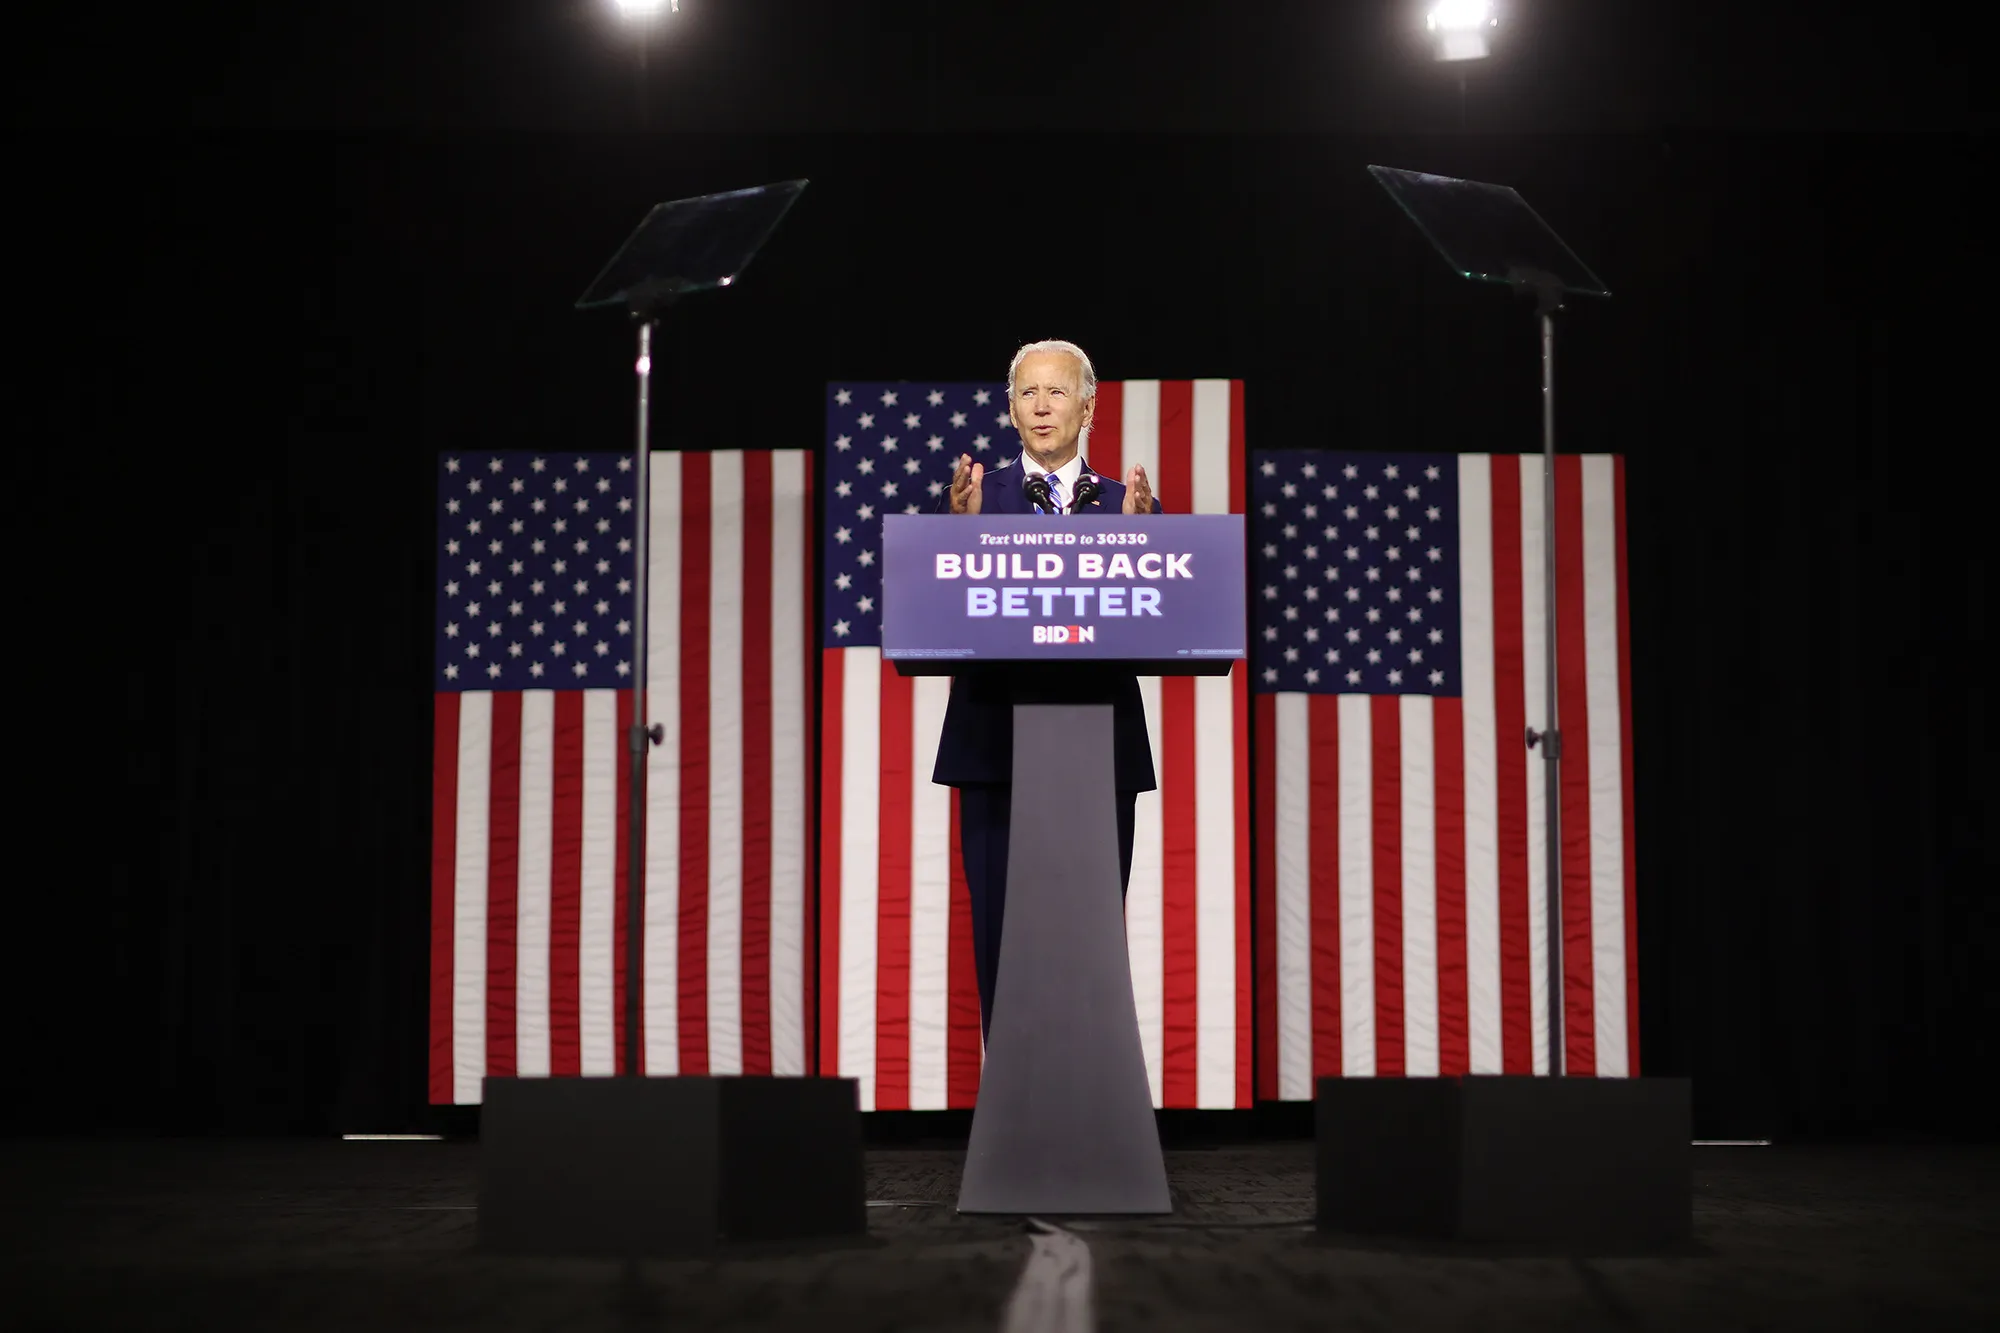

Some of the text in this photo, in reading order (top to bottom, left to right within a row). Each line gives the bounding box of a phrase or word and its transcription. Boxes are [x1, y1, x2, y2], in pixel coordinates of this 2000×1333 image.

[980, 533, 1148, 545] Text UNITED to 30330
[936, 553, 1193, 579] BUILD BACK
[966, 587, 1163, 617] BETTER
[1033, 625, 1094, 643] BIDEN
